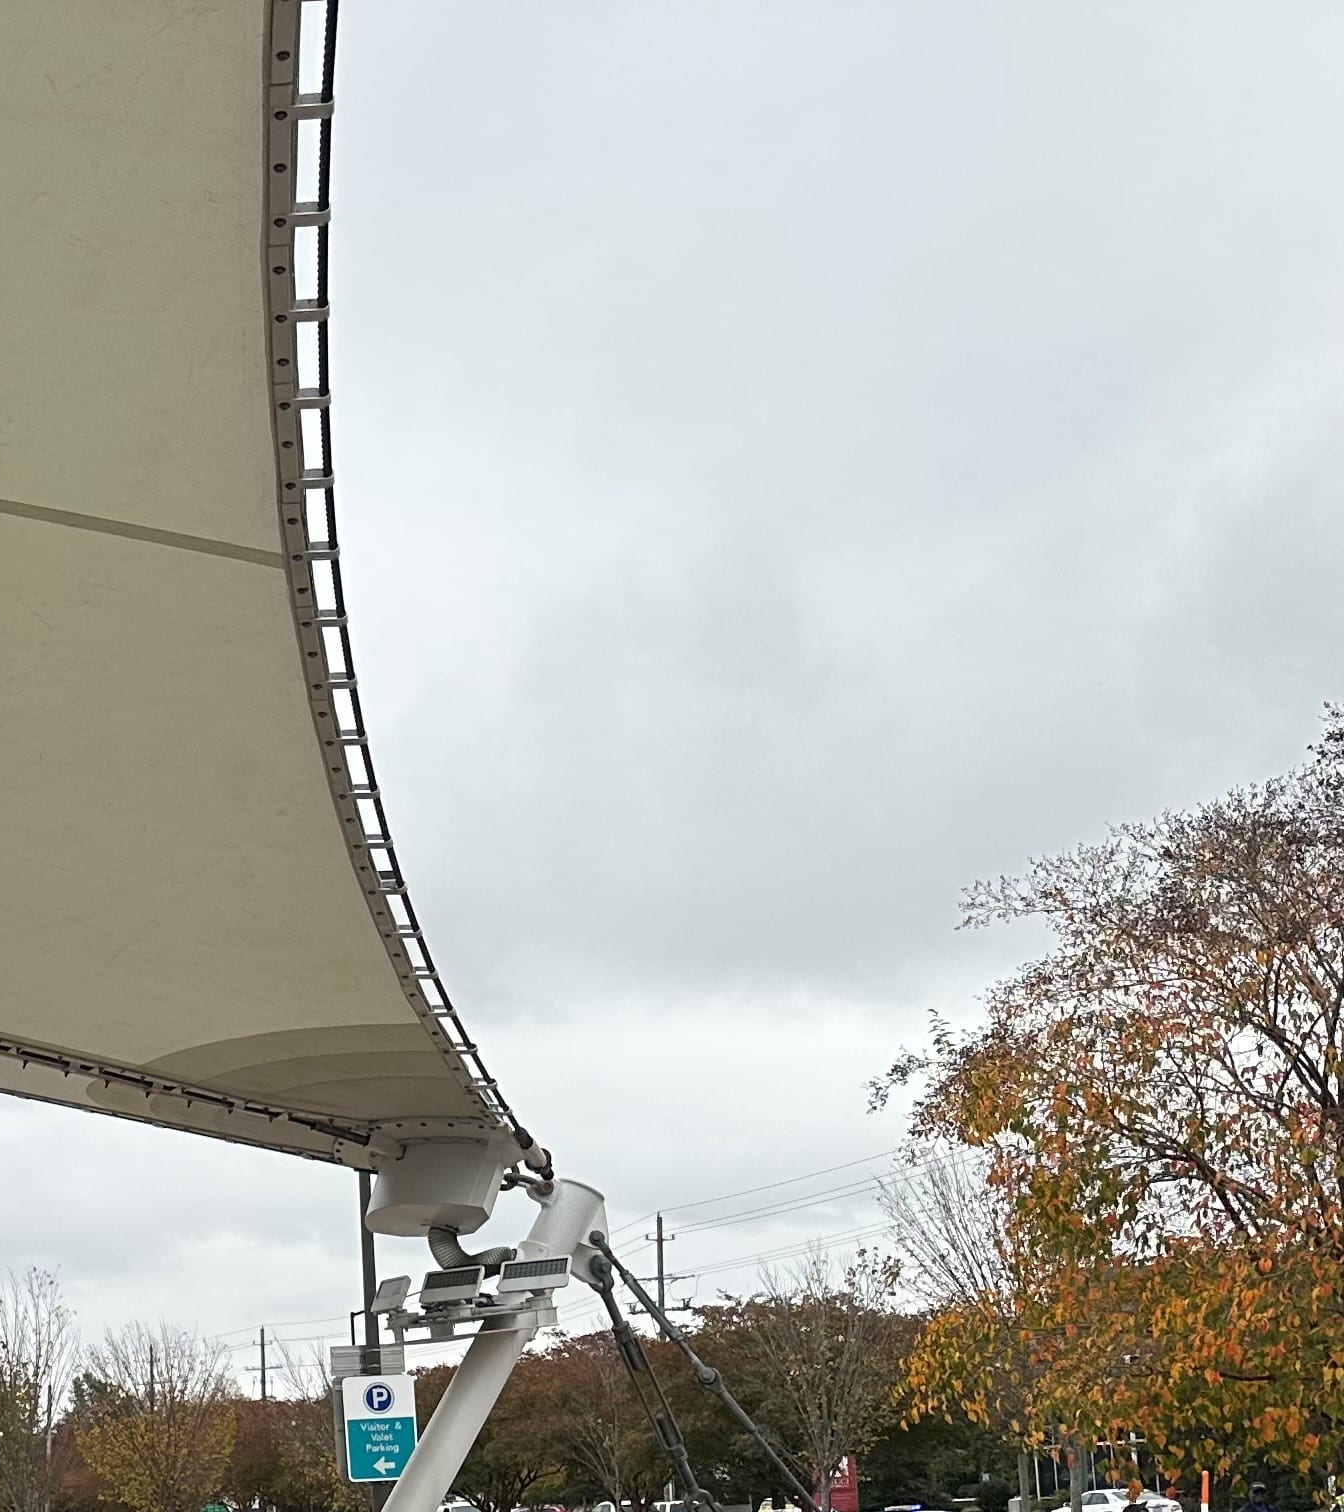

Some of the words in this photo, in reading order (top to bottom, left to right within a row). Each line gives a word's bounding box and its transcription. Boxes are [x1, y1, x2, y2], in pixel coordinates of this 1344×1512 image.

[372, 1387, 388, 1409] P
[360, 1423, 390, 1431] Visitor
[394, 1422, 402, 1430] &
[371, 1433, 394, 1441] Valet
[366, 1444, 399, 1453] Parking
